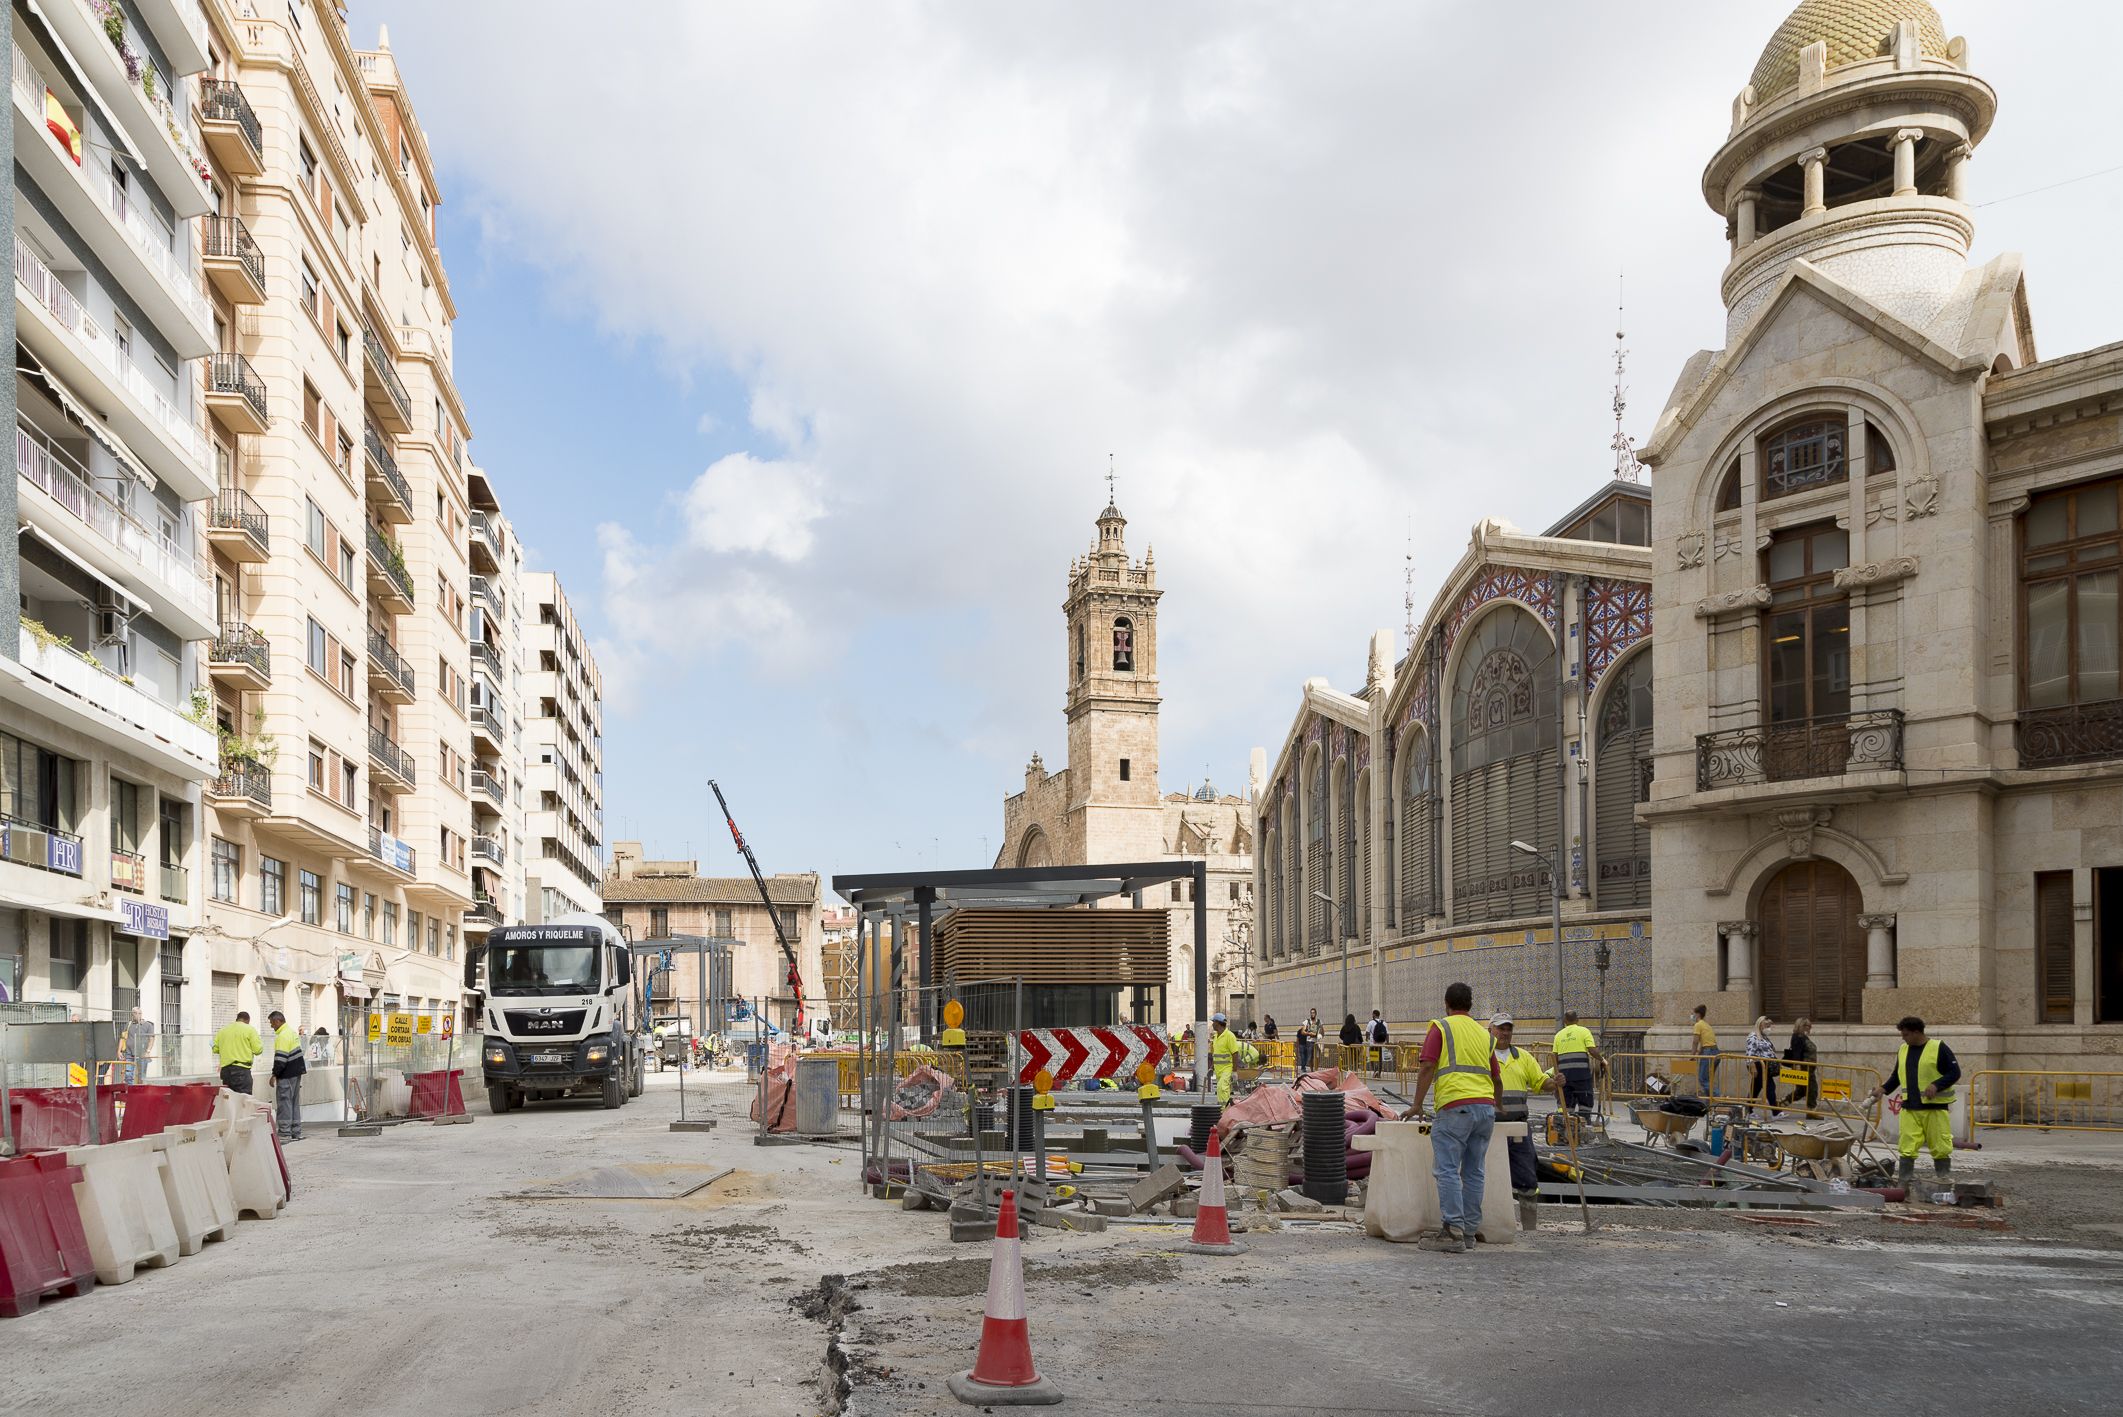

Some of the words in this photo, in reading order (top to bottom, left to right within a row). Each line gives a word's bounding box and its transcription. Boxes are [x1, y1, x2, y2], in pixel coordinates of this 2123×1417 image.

[144, 905, 168, 920] HOSTAL
[146, 917, 166, 931] BISBAL
[505, 931, 537, 940] AMOROS
[538, 931, 544, 939] Y
[545, 930, 583, 939] RIQUELME
[528, 1020, 564, 1029] MAN
[387, 1035, 398, 1043] POR
[398, 1035, 411, 1043] OBRAS
